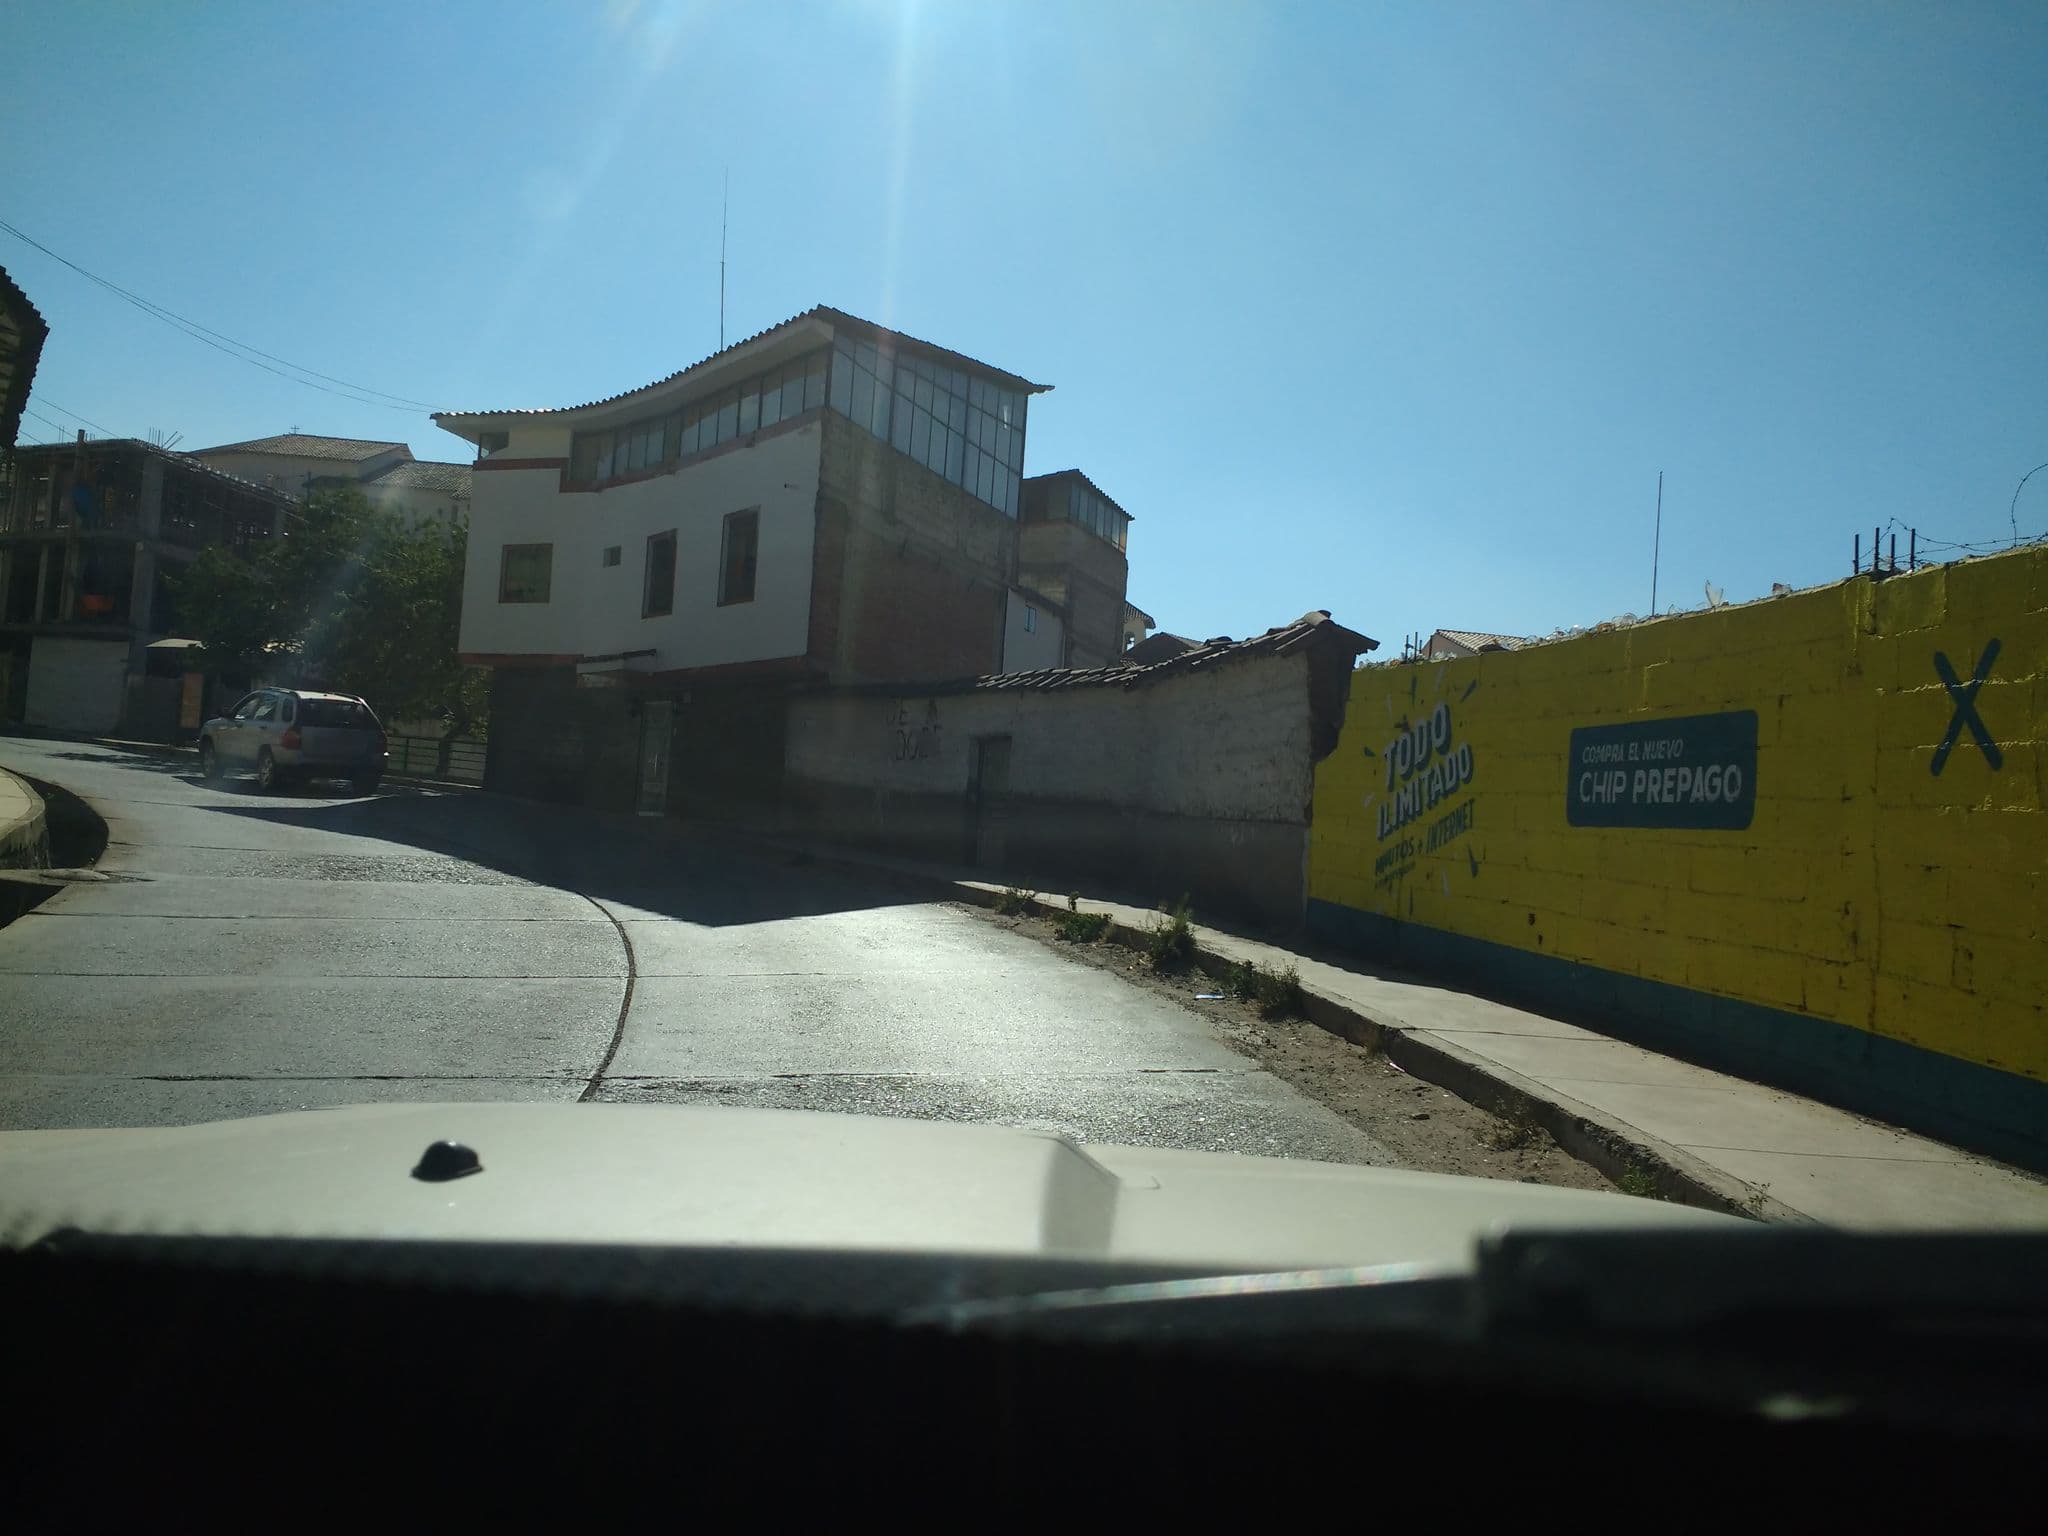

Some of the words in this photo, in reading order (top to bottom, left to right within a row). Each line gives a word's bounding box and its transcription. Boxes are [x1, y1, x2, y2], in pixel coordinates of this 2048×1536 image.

[1384, 702, 1451, 792] TODO
[1582, 744, 1624, 764] COMPRA
[1628, 742, 1640, 761] EL
[1642, 738, 1684, 761] NUEVO
[1376, 743, 1473, 842] ILIMITADO
[1579, 771, 1627, 804] CHIP
[1632, 764, 1742, 804] PREPAGO
[1425, 798, 1474, 856] INTERNET
